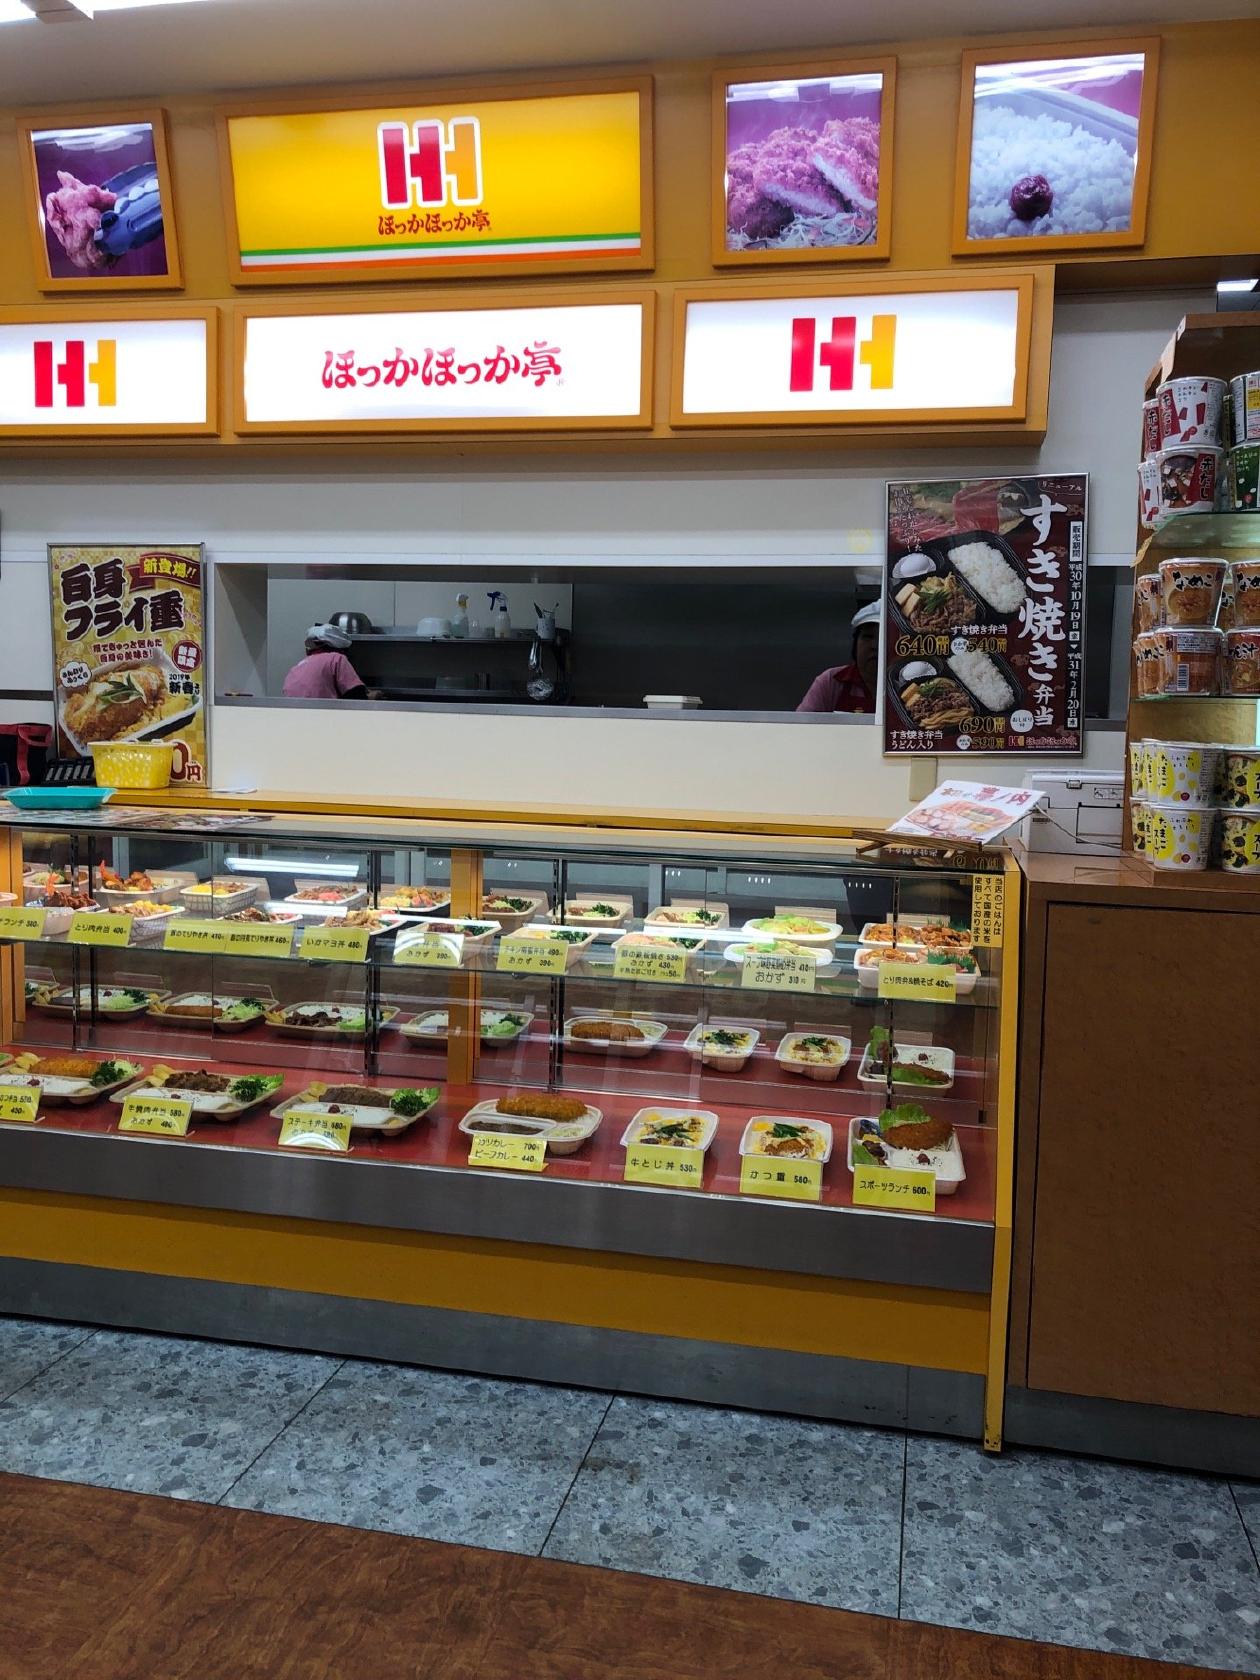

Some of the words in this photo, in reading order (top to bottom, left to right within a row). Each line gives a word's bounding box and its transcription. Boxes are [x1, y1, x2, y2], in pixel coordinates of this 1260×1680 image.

[378, 210, 489, 236] ほっかほっか亭
[322, 341, 562, 389] ほっかほっか亭
[1200, 455, 1212, 499] 赤だし
[61, 558, 127, 605] 白身
[64, 590, 185, 641] フライ重
[1018, 494, 1068, 728] すき焼き弁当
[951, 624, 1008, 635] すき焼き弁当
[890, 730, 943, 740] すき焼き弁当
[890, 740, 934, 750] うどん入り
[973, 877, 982, 943] 使用しております
[983, 877, 992, 944] すべて国産の米を
[993, 877, 1003, 936] 当店のごはんは
[755, 971, 785, 984] おかず
[475, 1149, 519, 1161] ビーフカレー
[630, 1157, 675, 1171] 牛とじ丼
[859, 1179, 911, 1194] スポーツランチ
